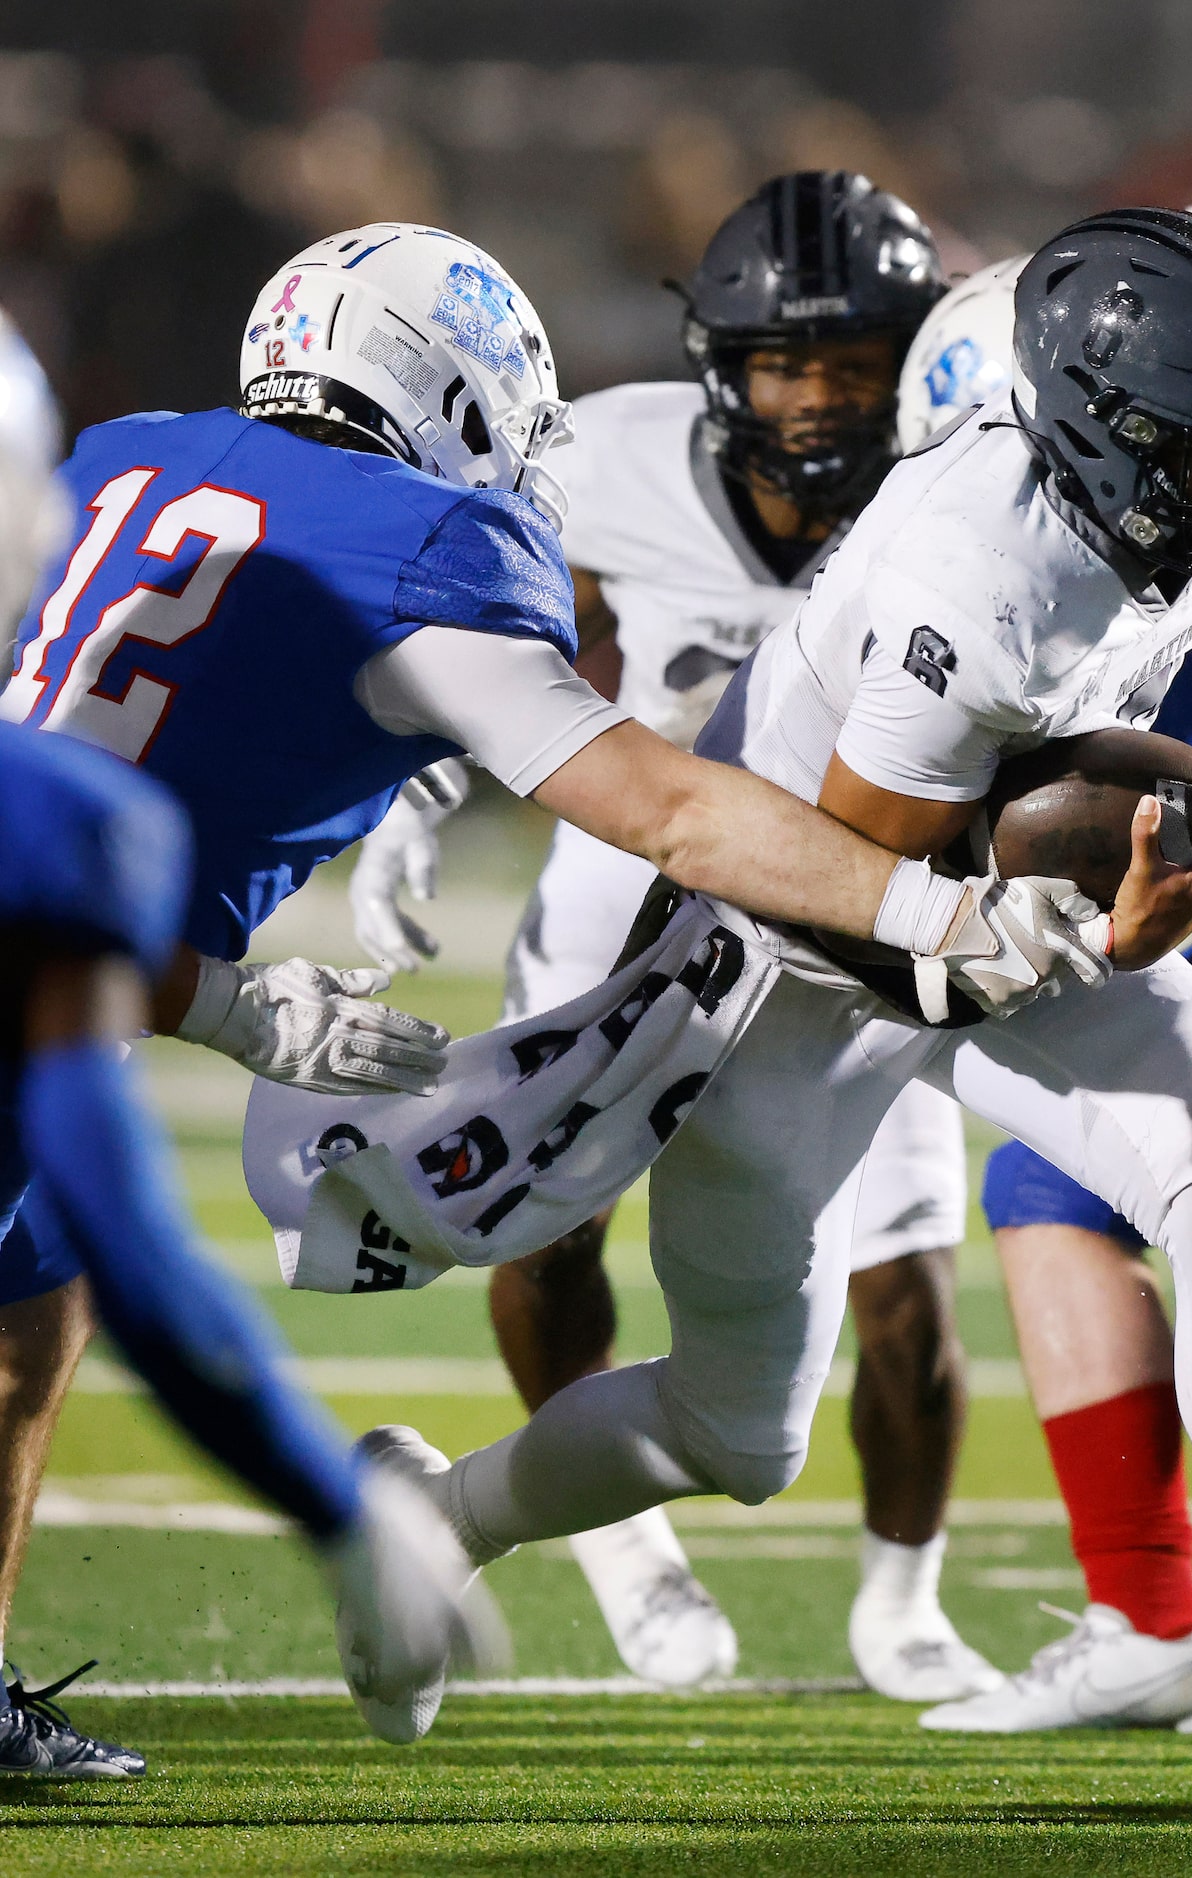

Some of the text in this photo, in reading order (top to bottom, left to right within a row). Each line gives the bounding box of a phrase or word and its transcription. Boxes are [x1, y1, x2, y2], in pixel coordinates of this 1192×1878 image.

[265, 339, 286, 369] 12
[395, 335, 424, 359] WARNING
[0, 466, 268, 766] 12
[902, 624, 960, 700] 6
